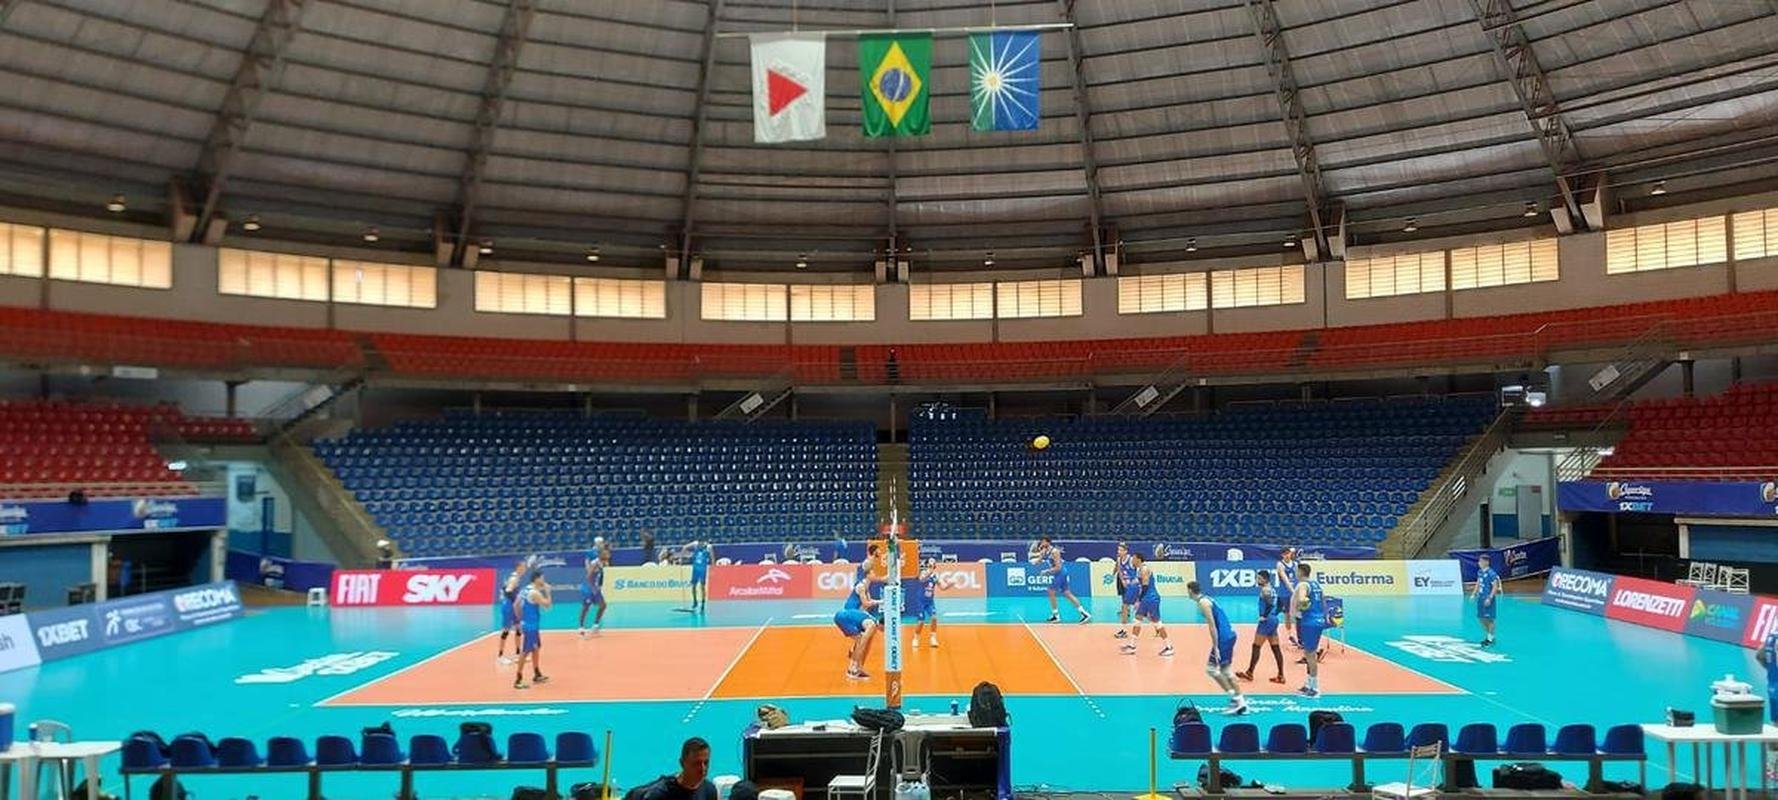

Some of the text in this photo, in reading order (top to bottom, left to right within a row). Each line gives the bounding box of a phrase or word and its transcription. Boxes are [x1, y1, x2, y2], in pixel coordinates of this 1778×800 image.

[336, 573, 381, 605] FIAT
[402, 573, 473, 603] SKY
[1210, 569, 1280, 587] 1XBT
[1316, 572, 1394, 585] Eurofarma
[1414, 577, 1430, 587] EY
[1612, 590, 1686, 618] LORENZETTI
[37, 619, 89, 648] 1XBET
